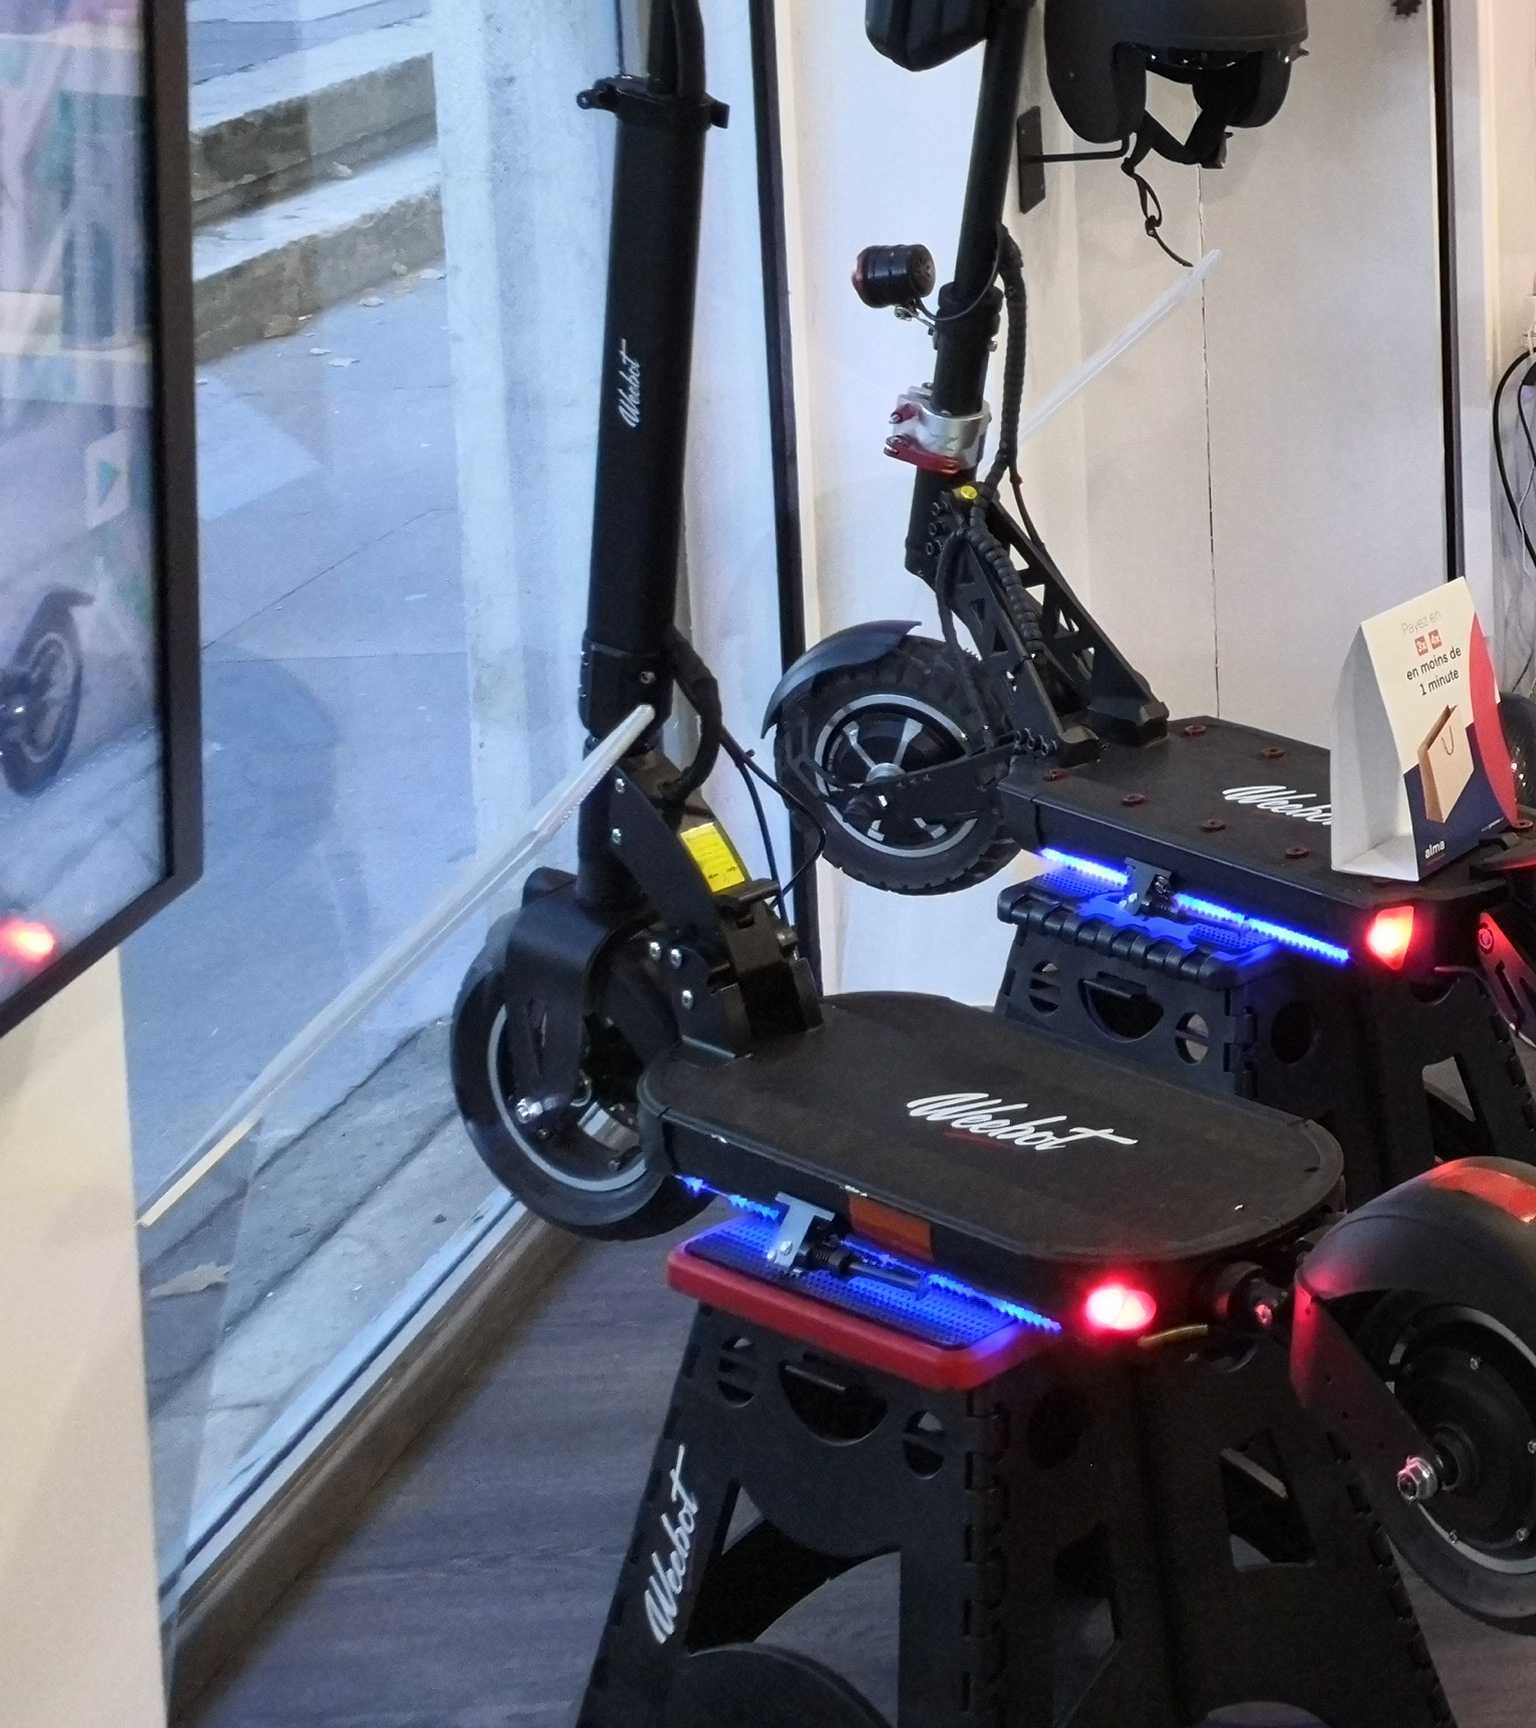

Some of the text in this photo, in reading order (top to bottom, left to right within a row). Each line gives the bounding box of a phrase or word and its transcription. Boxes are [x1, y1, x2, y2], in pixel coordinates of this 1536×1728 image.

[619, 338, 641, 428] Weebot
[1407, 646, 1462, 680] en moins de
[1420, 669, 1459, 696] 1 minute
[1222, 785, 1332, 826] Weebo
[1425, 839, 1446, 860] alma
[906, 1092, 1139, 1151] Weebot
[644, 1443, 699, 1645] Weebot
